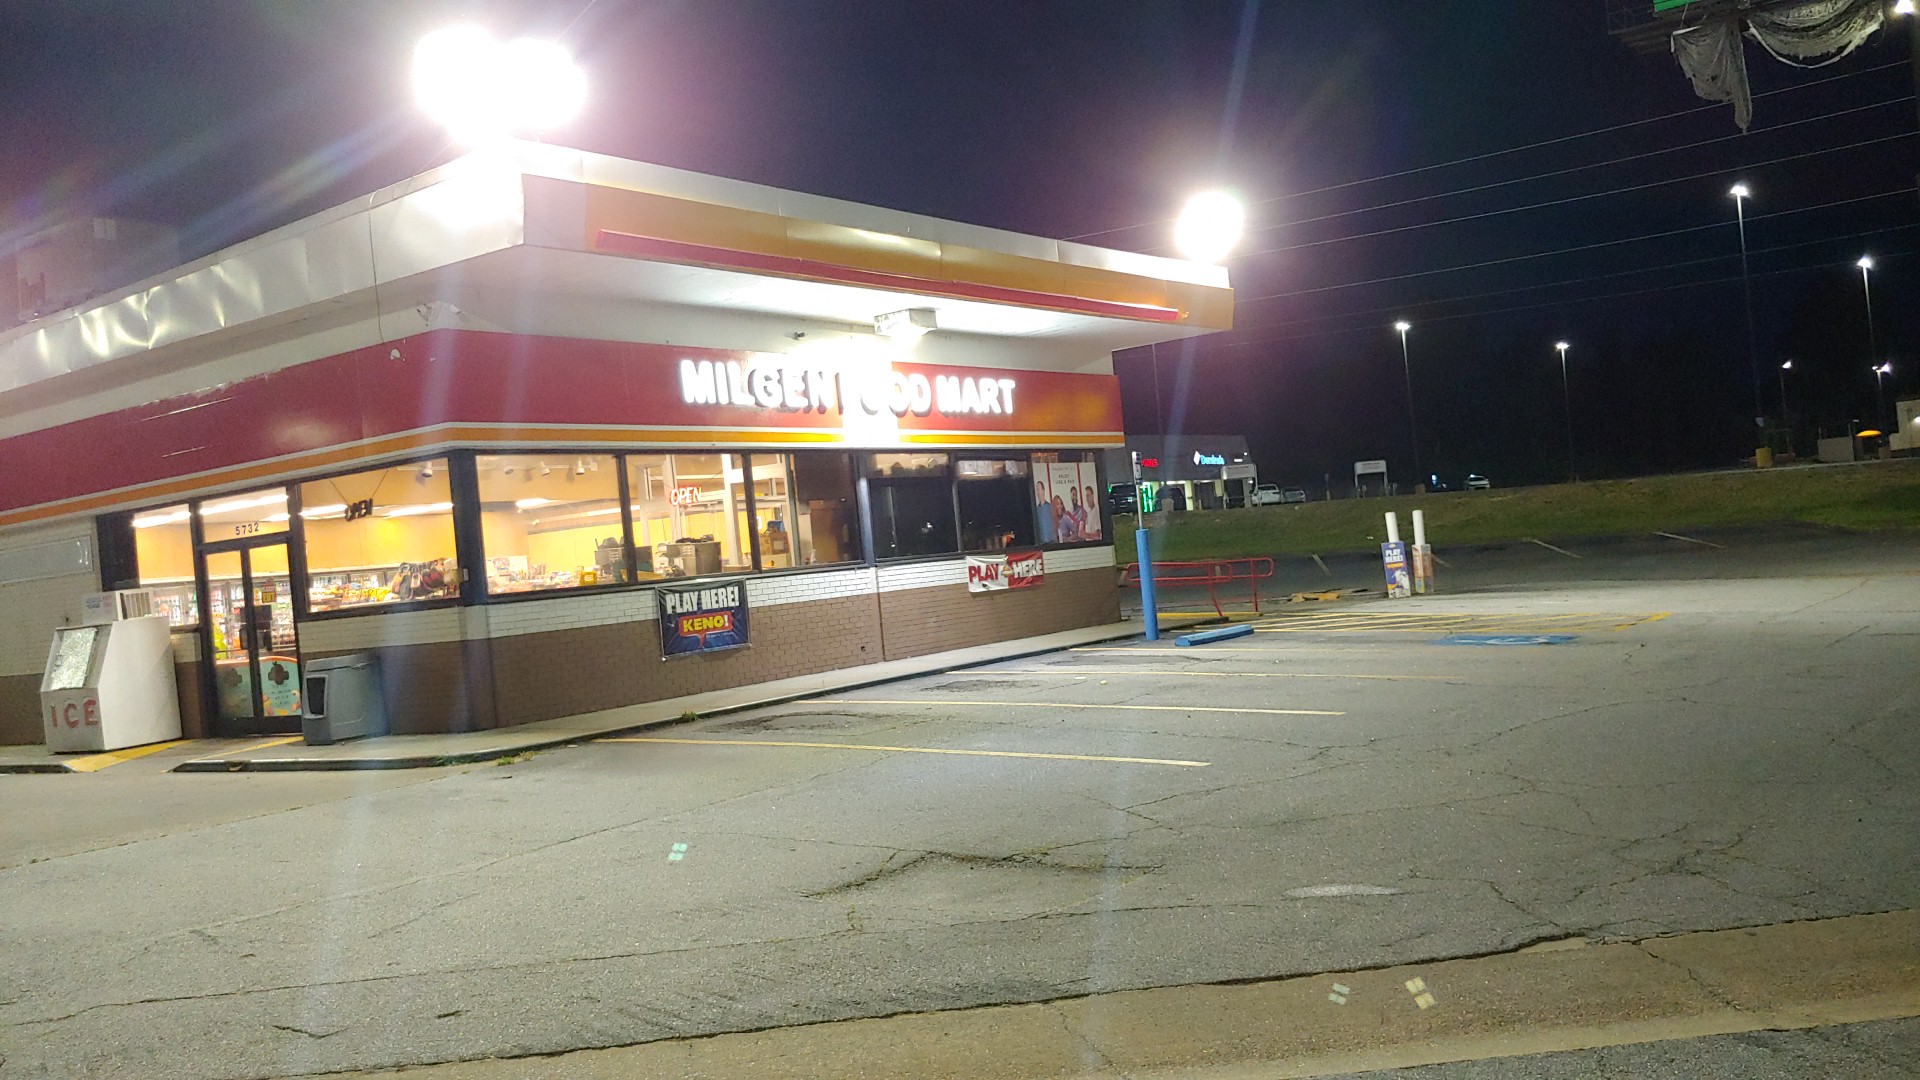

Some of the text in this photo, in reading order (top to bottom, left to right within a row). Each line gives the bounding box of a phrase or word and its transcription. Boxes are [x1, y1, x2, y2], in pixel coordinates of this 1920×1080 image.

[680, 358, 1016, 417] MILGEN OD MART
[670, 486, 702, 506] OPEN
[235, 523, 260, 536] 5732
[968, 559, 1043, 583] PLAY HERE
[666, 586, 740, 615] PLAY HERE!
[683, 614, 729, 632] KENO!
[50, 699, 98, 729] ICE
